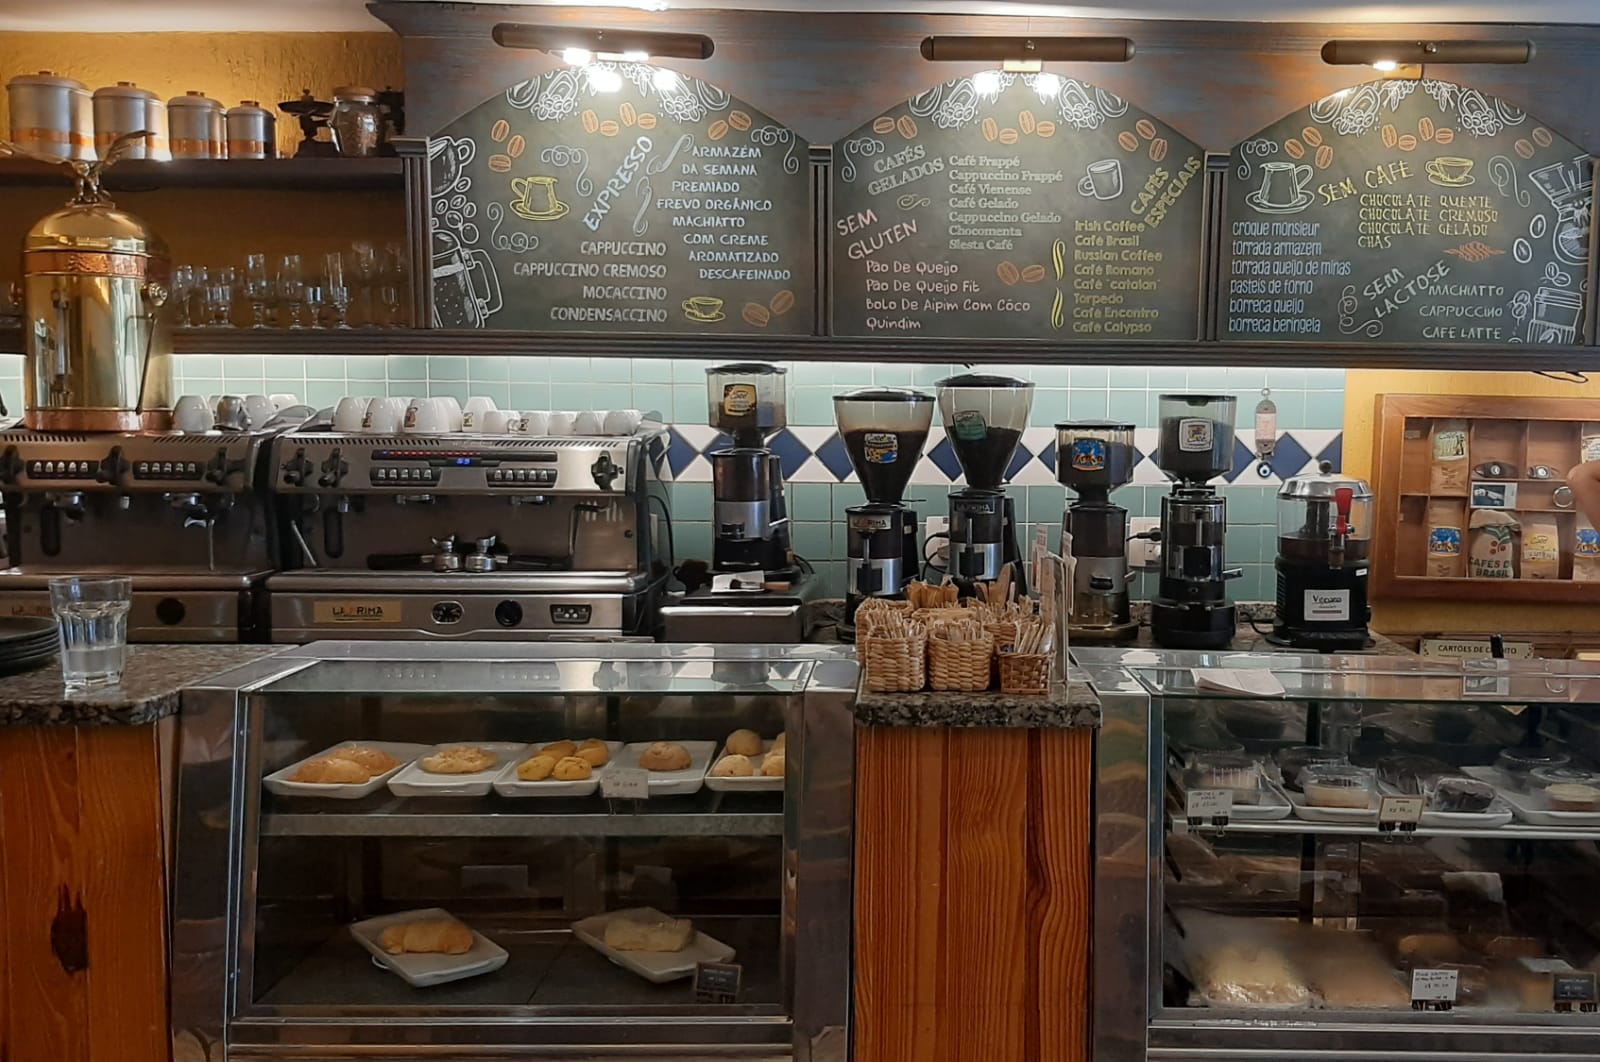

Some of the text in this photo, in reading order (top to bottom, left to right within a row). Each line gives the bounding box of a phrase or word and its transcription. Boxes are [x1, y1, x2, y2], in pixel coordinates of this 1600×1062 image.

[692, 145, 762, 158] ARMAZÉM
[873, 144, 926, 173] CAFÉS
[949, 155, 1020, 169] Café Frappé
[682, 164, 757, 176] DA SEMANA
[868, 158, 945, 195] GELADOS
[949, 170, 1063, 183] Cappuccino Frappé
[582, 136, 652, 231] EXPRESSO
[672, 181, 740, 192] PREMIADO
[949, 184, 1032, 195] Café Vienense
[1144, 156, 1201, 228] ESPECIAIS
[1318, 177, 1357, 206] SEM
[656, 197, 772, 211] FREVO ORGÂNICO
[949, 198, 1019, 208] Café Gelado
[1359, 193, 1492, 208] CHOCOLATE QUENTE
[672, 216, 745, 227] MACHIATTO
[949, 211, 1061, 224] Cappuccino Gelado
[1359, 208, 1498, 222] CHOCOLATE CREMOSO
[836, 209, 878, 236] SEM
[1074, 220, 1145, 232] Irish Coffee
[1232, 221, 1320, 237] croque monsieur
[1358, 222, 1488, 236] CHOCOLATE GELADO
[949, 225, 1022, 236] Chocomenta
[683, 234, 768, 245] COM CREME
[848, 219, 917, 259] GLUTEN
[949, 239, 1013, 250] Siesta Café
[1074, 235, 1139, 246] Café Brasil
[580, 241, 667, 256] CAPPUCCINO
[1232, 240, 1271, 256] torrada
[689, 251, 779, 263] AROMATIZADO
[1074, 250, 1162, 262] Russian Coffee
[513, 262, 667, 278] CAPPUCCINO CREMOSO
[700, 269, 791, 280] DESCAFEINADO
[893, 261, 911, 273] De
[916, 261, 958, 276] Queijo
[1074, 264, 1154, 276] Café Romano
[1232, 260, 1351, 276] torrada queijo de minas
[893, 280, 911, 292] De
[916, 279, 958, 295] Queijo
[963, 280, 980, 293] Fit
[1074, 278, 1103, 290] Café
[1268, 279, 1281, 294] de
[1284, 280, 1313, 294] forno
[1363, 268, 1405, 300] SEM
[1375, 259, 1450, 318] LACTOSE
[1428, 285, 1504, 296] MACHIATTO
[583, 285, 667, 300] MOCACCINO
[1074, 293, 1124, 306] Torpedo
[901, 299, 919, 311] De
[924, 299, 958, 313] Aipim
[963, 299, 992, 311] Com
[1105, 307, 1159, 319] Encontro
[1229, 298, 1304, 315] borreca queijo
[1419, 305, 1503, 318] CAPPUCCINO
[551, 307, 667, 322] CONDENSACCINO
[866, 317, 921, 331] Quindim
[1104, 322, 1151, 335] Calypso
[1229, 317, 1320, 333] borreca beringela
[1423, 326, 1502, 340] CAFE LATTE
[1475, 569, 1509, 578] BRASIL
[1474, 645, 1483, 653] DE
[1485, 645, 1517, 654] CITO
